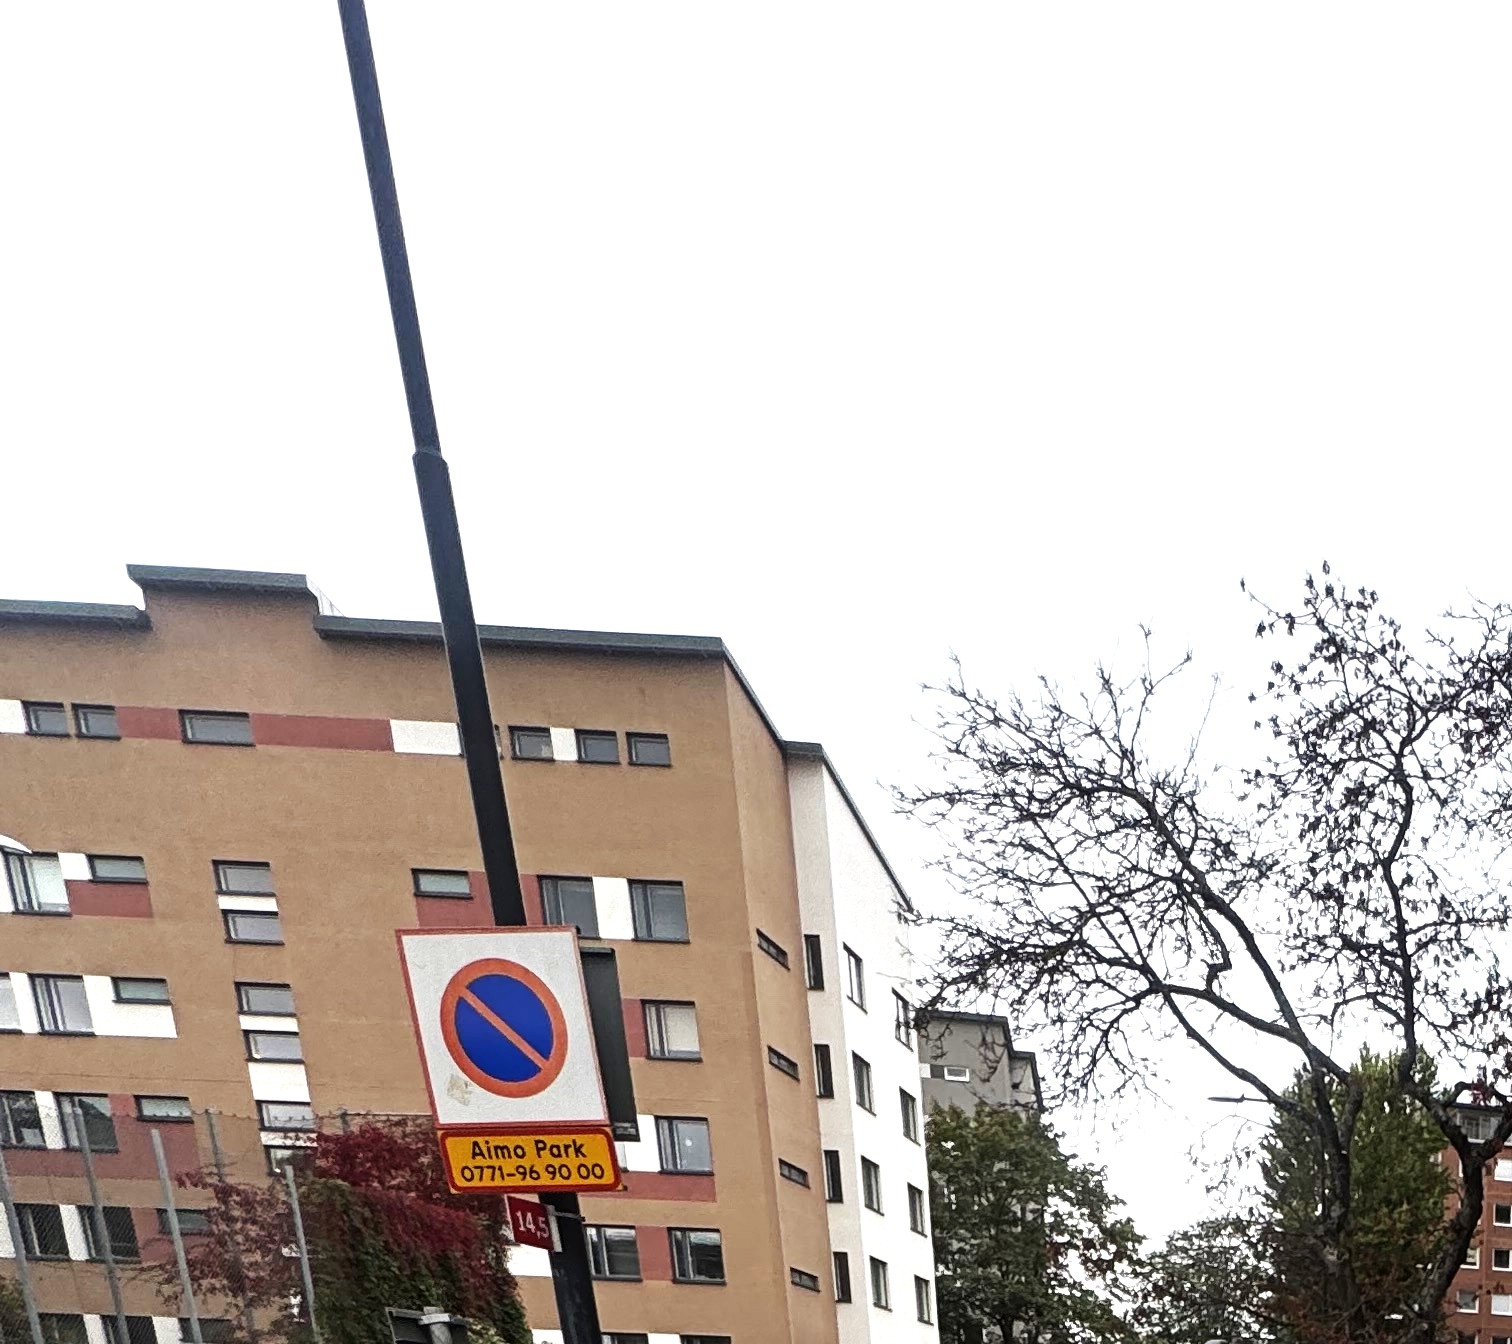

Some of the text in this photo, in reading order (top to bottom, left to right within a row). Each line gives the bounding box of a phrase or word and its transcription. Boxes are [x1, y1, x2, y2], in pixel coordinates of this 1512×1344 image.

[471, 1139, 587, 1160] Aimo Park
[460, 1163, 605, 1182] 0771-96 90 00
[515, 1209, 550, 1240] 14,5
